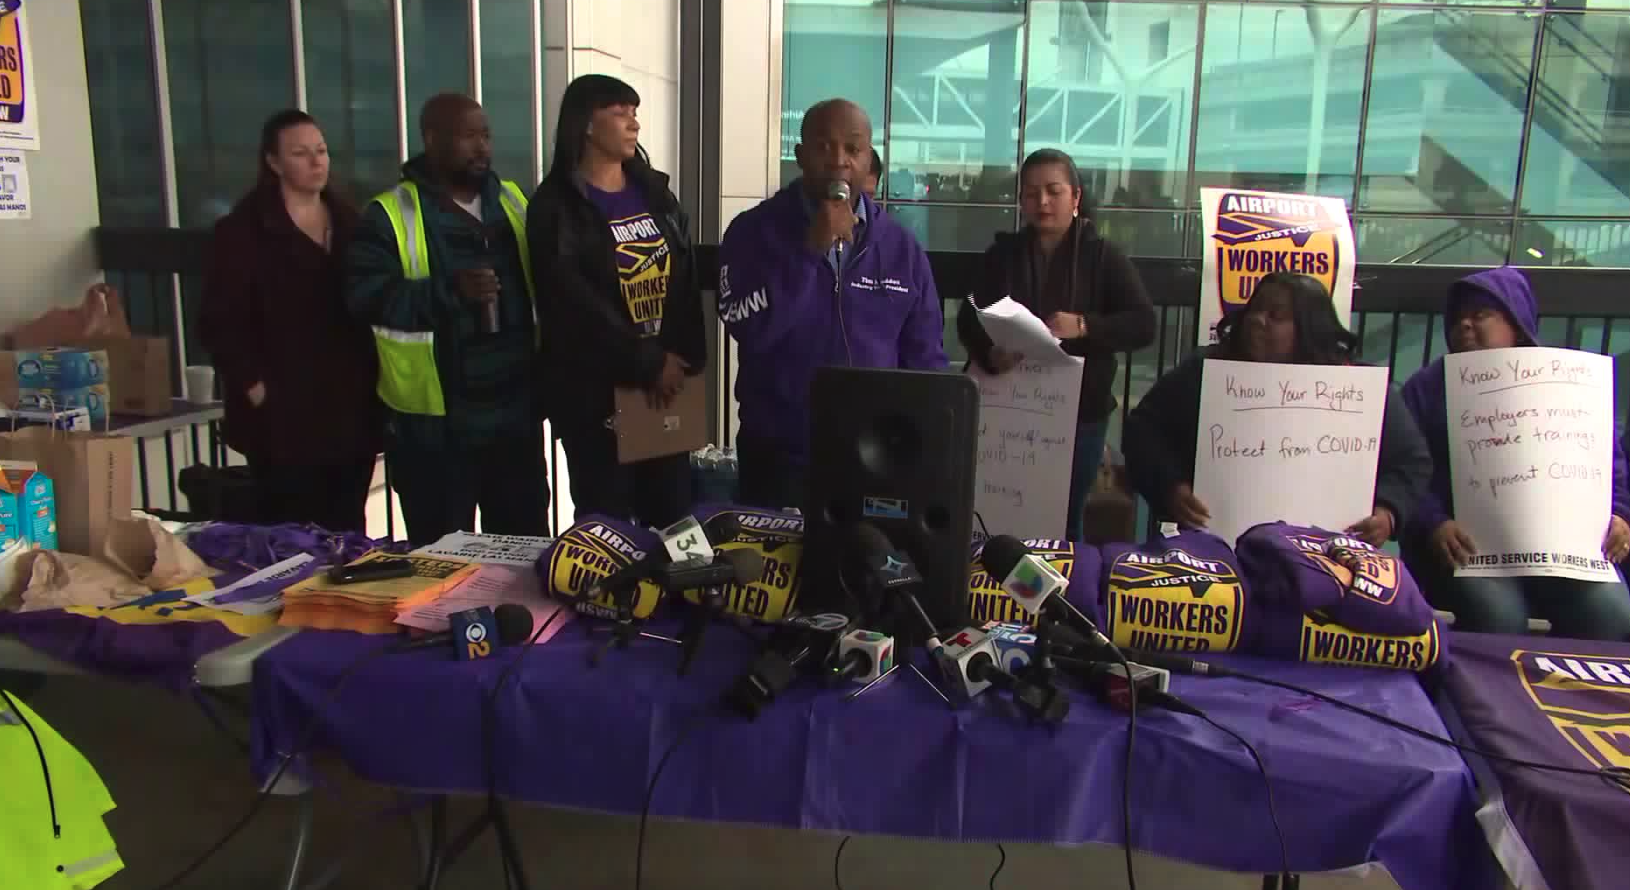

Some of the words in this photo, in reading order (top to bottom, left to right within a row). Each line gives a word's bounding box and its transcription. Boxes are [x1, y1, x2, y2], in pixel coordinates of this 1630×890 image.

[1227, 195, 1317, 214] AIRPORT
[611, 218, 661, 243] AIRPORT
[1254, 224, 1318, 241] JUSTICE
[639, 243, 670, 272] JUSTICE
[1227, 248, 1329, 275] WORKERS
[1459, 366, 1502, 388] Know
[1507, 359, 1545, 383] Your
[1226, 374, 1266, 400] Know
[1279, 381, 1308, 406] Your
[1315, 381, 1364, 411] Rights
[1460, 407, 1539, 434] Employers
[1209, 423, 1266, 464] Protect
[1278, 436, 1311, 459] from
[1489, 465, 1539, 498] prevent
[1127, 549, 1219, 573] AIRPORT
[1466, 553, 1499, 566] NITED
[1501, 552, 1548, 564] SERVICE
[1551, 553, 1590, 569] WORKERS
[1590, 559, 1610, 572] WEST
[1151, 574, 1222, 587] JUSTICE
[1121, 594, 1228, 635] WORKERS
[1314, 630, 1424, 669] WORKERS
